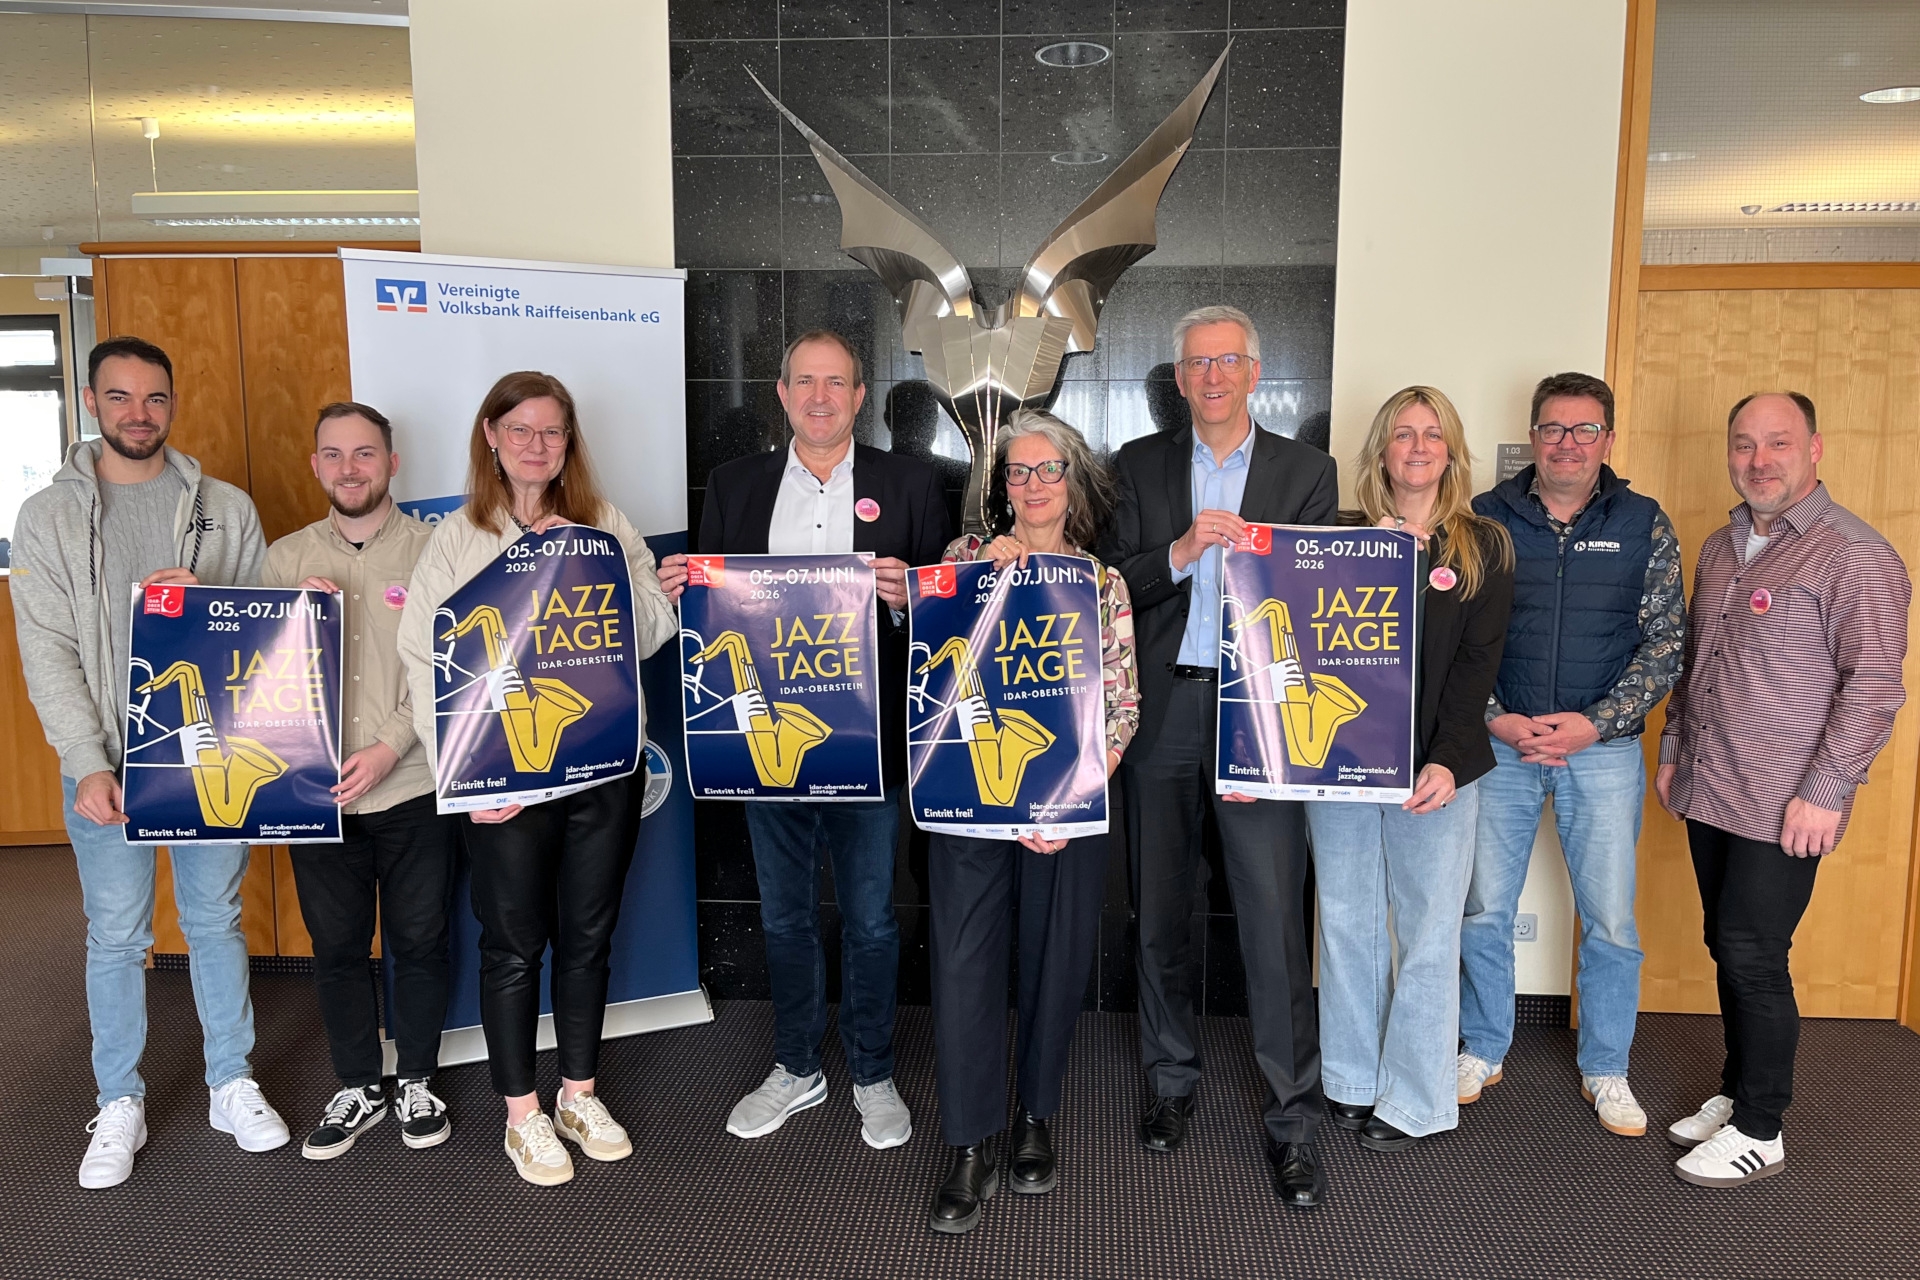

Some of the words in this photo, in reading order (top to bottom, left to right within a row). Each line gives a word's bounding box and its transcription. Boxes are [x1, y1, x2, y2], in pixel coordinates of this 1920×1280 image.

[438, 282, 520, 300] Vereinigte
[438, 300, 520, 317] Volksbank
[525, 305, 637, 323] Raiffeisenbank
[640, 310, 660, 324] eG
[1505, 447, 1521, 455] 1.03
[1587, 540, 1621, 549] KIRNER
[505, 562, 537, 573] 2026
[1294, 559, 1325, 570] 2026
[750, 589, 780, 600] 2026
[527, 583, 619, 622] JAZZ
[1311, 586, 1399, 619] JAZZ
[207, 621, 241, 632] 2026
[770, 612, 859, 649] JAZZ
[994, 612, 1083, 653] JAZZ
[527, 619, 622, 655] TAGE
[1310, 622, 1400, 652] TAGE
[226, 648, 323, 682] JAZZ
[537, 654, 624, 670] IDAR-OBERSTEIN
[770, 647, 862, 681] TAGE
[994, 648, 1086, 686] TAGE
[1317, 657, 1400, 666] IDAR-OBERSTEIN
[780, 682, 863, 695] IDAR-OBERSTEIN
[1003, 686, 1087, 701] IDAR-OBERSTEIN
[225, 683, 325, 714] TAGE
[233, 718, 325, 729] IDAR-OBERSTEIN
[565, 759, 625, 774] idar-oberstein.de/
[1228, 764, 1260, 776] Eintritt
[1338, 765, 1398, 776] idar-oberstein.de/
[565, 770, 593, 781] jazztage
[1337, 772, 1366, 782] jazztage
[450, 780, 485, 791] Eintritt
[487, 777, 507, 788] frei!
[704, 787, 735, 795] Eintritt
[736, 787, 755, 795] frei!
[923, 808, 953, 818] Eintritt
[955, 808, 974, 818] frei!
[138, 829, 174, 838] Eintritt
[175, 829, 197, 837] frei!
